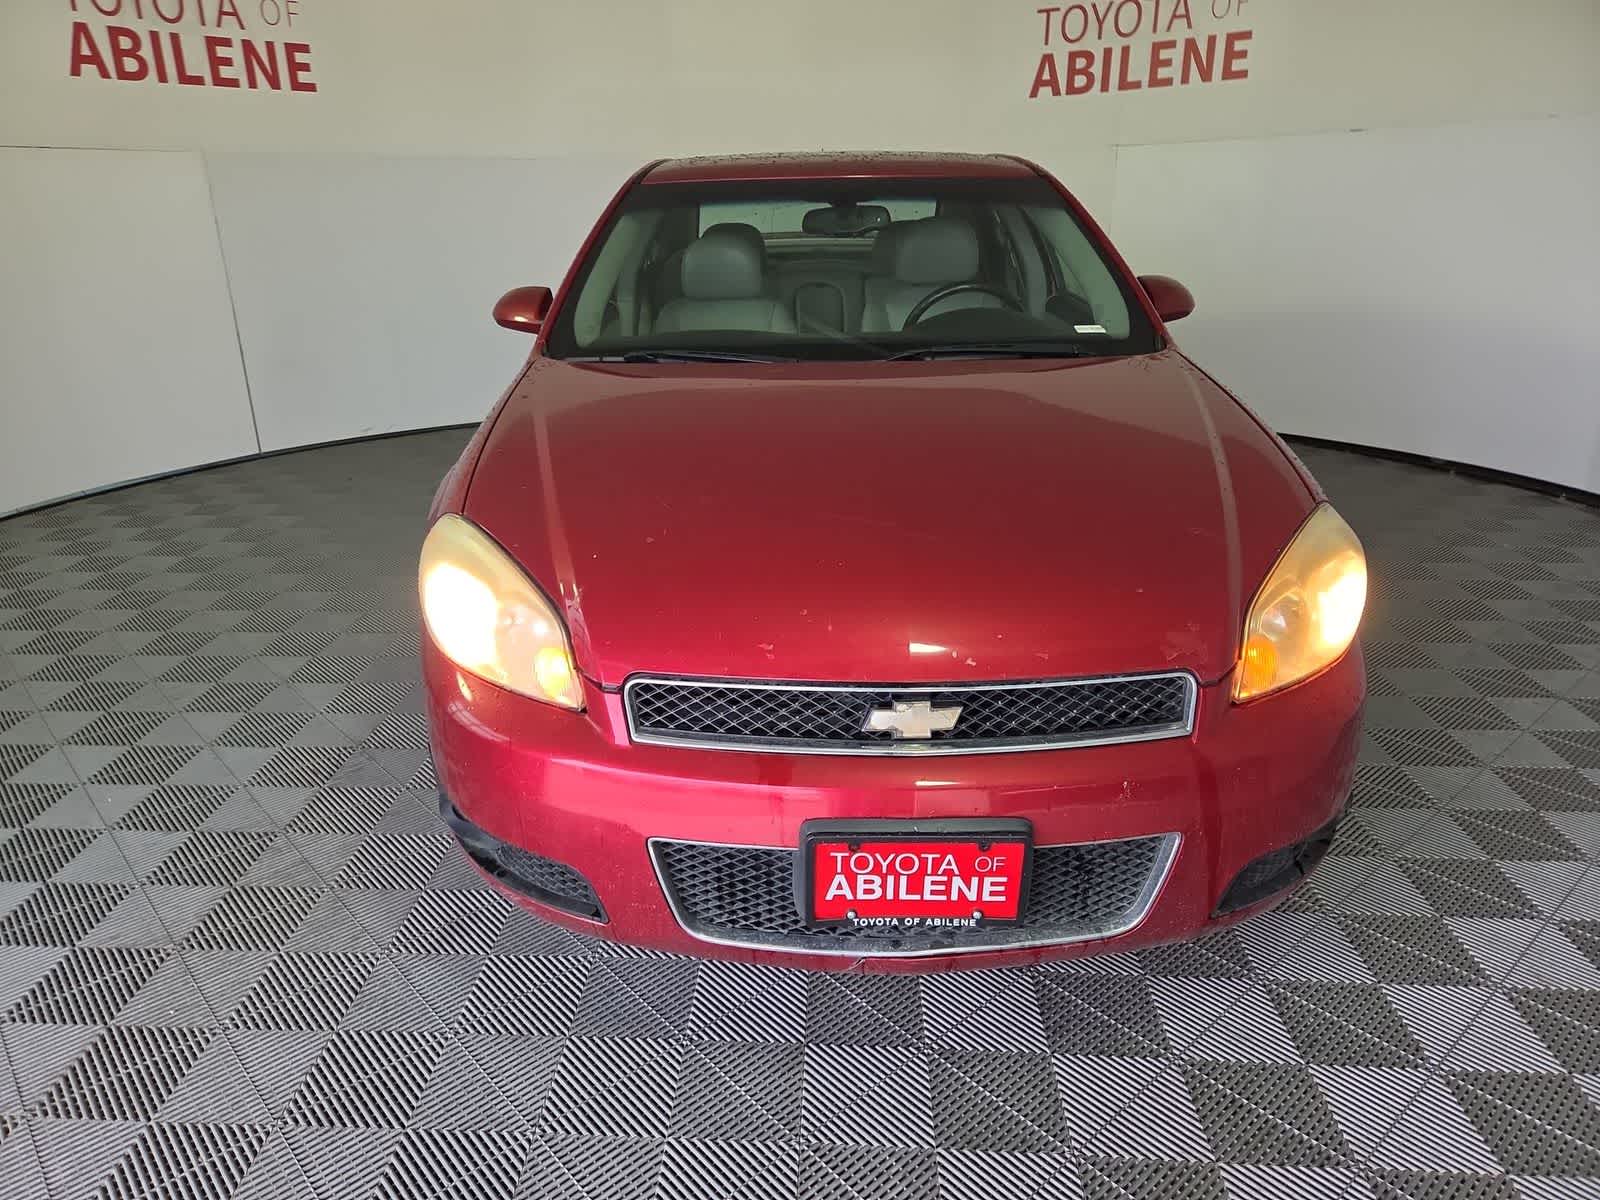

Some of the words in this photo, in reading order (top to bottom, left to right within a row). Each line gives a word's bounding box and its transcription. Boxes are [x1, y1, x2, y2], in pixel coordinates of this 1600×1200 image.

[260, 0, 299, 28] OF
[1036, 0, 1193, 46] TOYOTA
[70, 21, 318, 93] ABILENE
[1029, 30, 1253, 98] ABILENE
[830, 851, 960, 875] TOYOTA
[974, 856, 1007, 872] OF
[824, 874, 1008, 902] ABILENE
[852, 918, 899, 926] TOYOTA
[904, 918, 920, 926] OF
[925, 918, 977, 927] ABILENE
